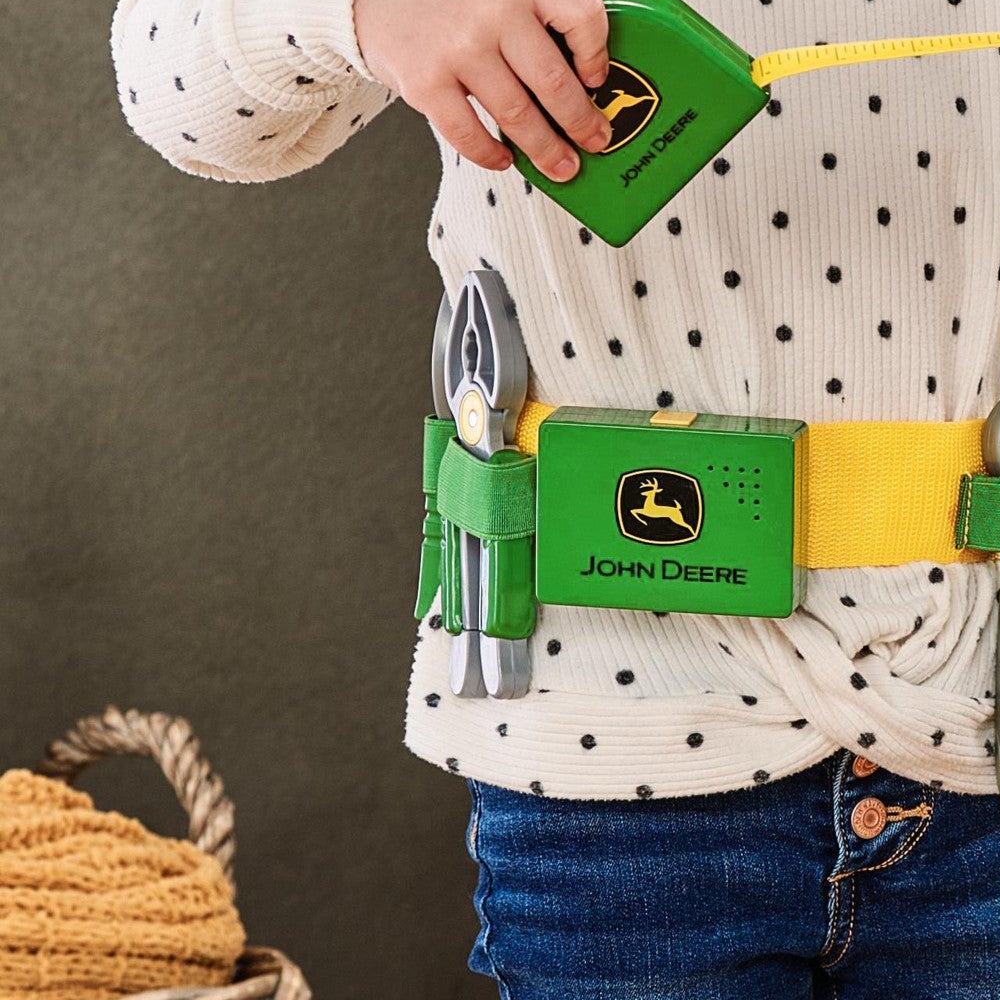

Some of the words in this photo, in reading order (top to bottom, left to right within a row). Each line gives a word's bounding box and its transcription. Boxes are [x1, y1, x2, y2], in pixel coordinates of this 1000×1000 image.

[620, 150, 656, 188] JOHN
[651, 109, 698, 152] DEERE
[580, 555, 656, 579] JOHN
[662, 559, 748, 585] DEERE
